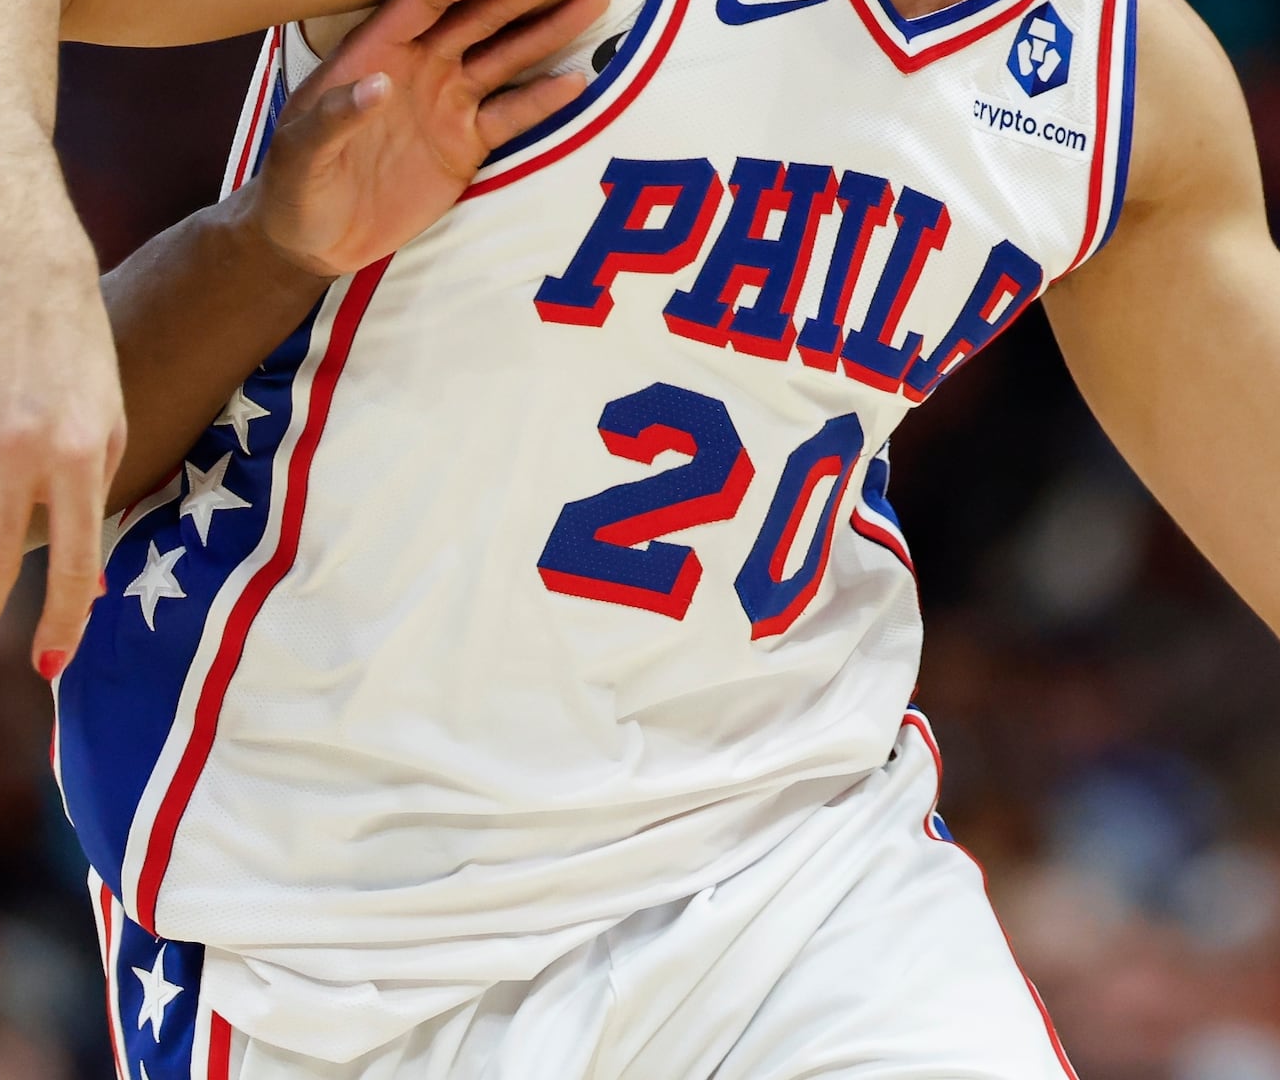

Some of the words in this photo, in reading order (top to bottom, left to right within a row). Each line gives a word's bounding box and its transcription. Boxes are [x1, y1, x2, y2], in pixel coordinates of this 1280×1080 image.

[972, 99, 1087, 152] crypto.com
[533, 156, 1044, 402] PHILA
[537, 382, 866, 641] 20
